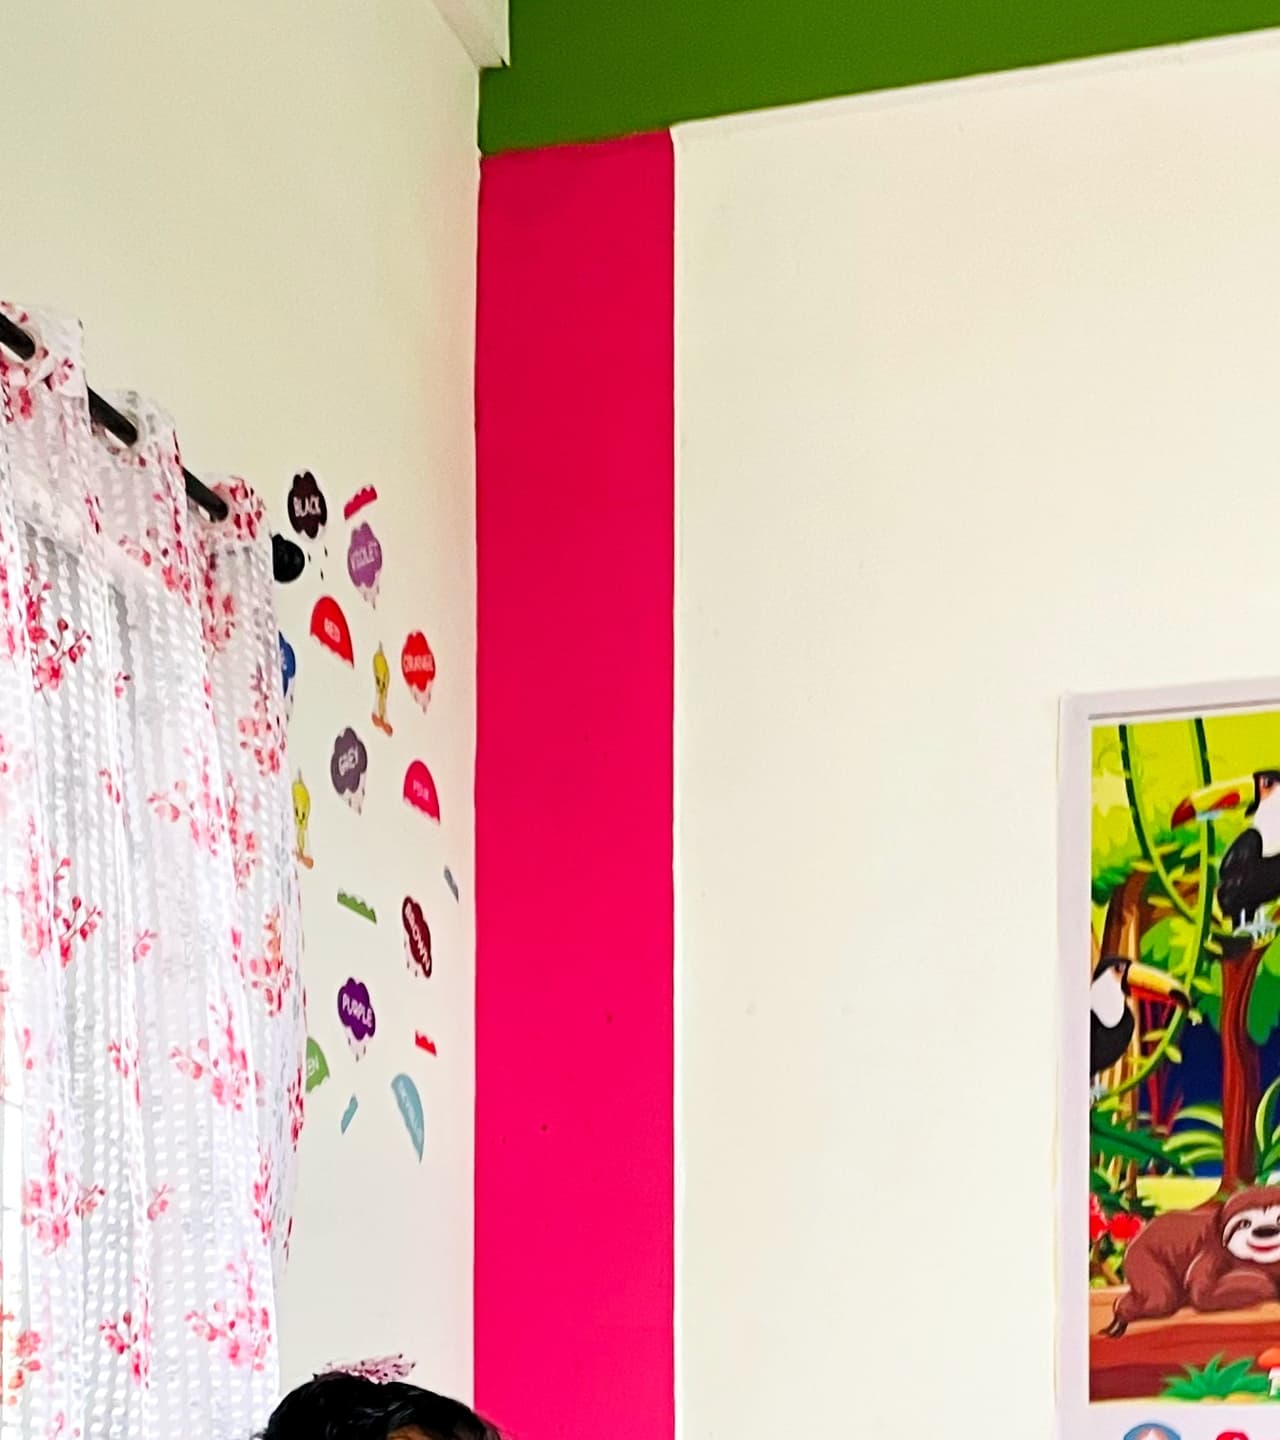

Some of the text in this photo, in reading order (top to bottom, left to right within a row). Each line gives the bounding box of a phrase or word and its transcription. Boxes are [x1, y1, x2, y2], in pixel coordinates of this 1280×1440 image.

[292, 494, 322, 518] BLACK
[349, 540, 379, 572] VIOLET
[323, 617, 341, 644] RED
[404, 901, 431, 972] BROWN
[342, 992, 374, 1029] PURPLE
